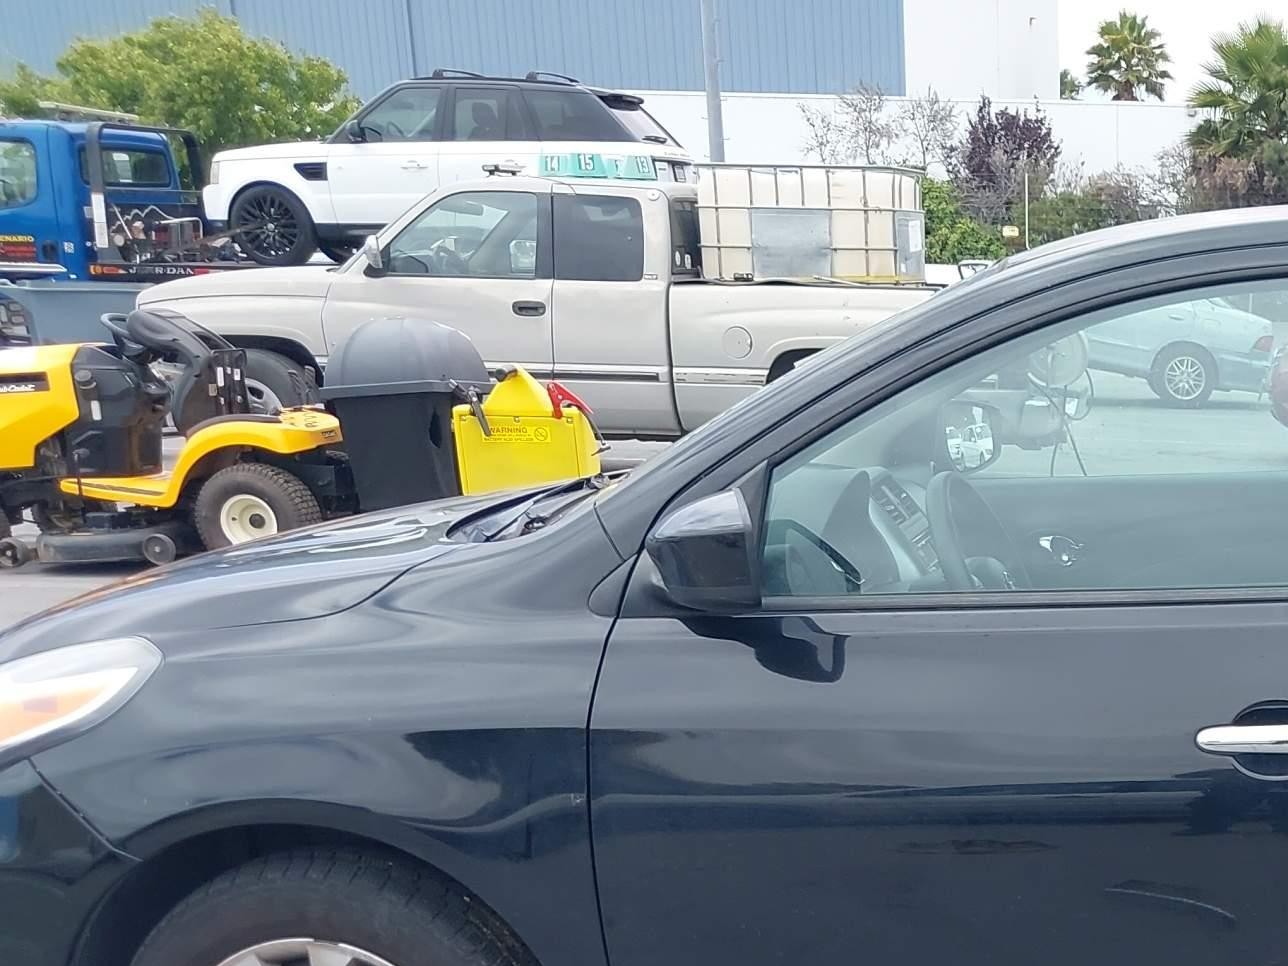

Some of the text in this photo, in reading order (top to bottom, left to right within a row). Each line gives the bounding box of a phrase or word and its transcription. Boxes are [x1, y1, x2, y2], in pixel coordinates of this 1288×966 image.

[545, 155, 560, 171] 14
[577, 153, 595, 171] 15
[635, 155, 650, 173] 13
